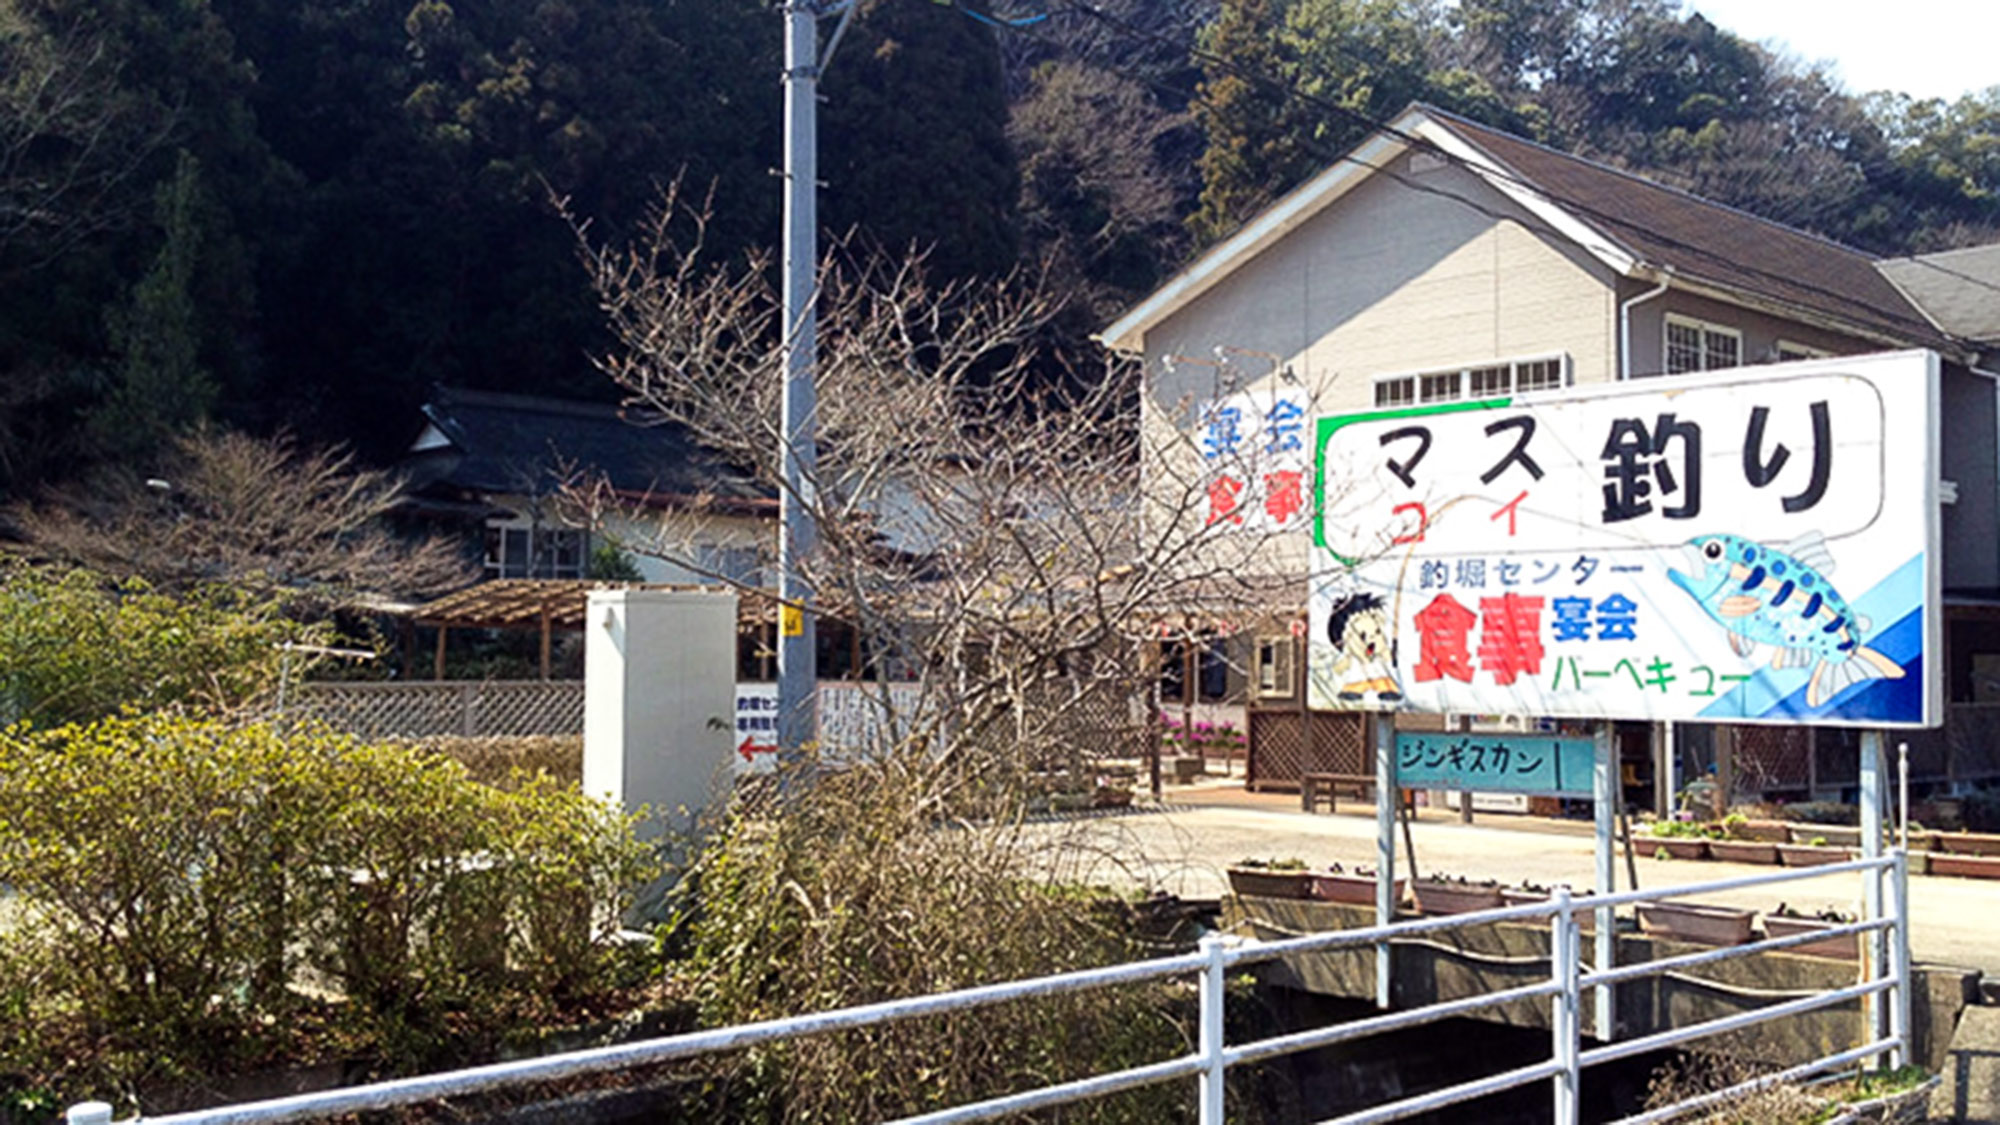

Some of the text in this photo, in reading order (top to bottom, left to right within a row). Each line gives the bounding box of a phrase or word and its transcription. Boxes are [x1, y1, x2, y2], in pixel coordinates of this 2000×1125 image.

[1391, 490, 1530, 545] コイ
[1419, 555, 1644, 589] 釣堀センター
[1412, 592, 1546, 687] 食事
[1552, 593, 1638, 643] 宴会
[1402, 738, 1543, 774] ジンギスカン
